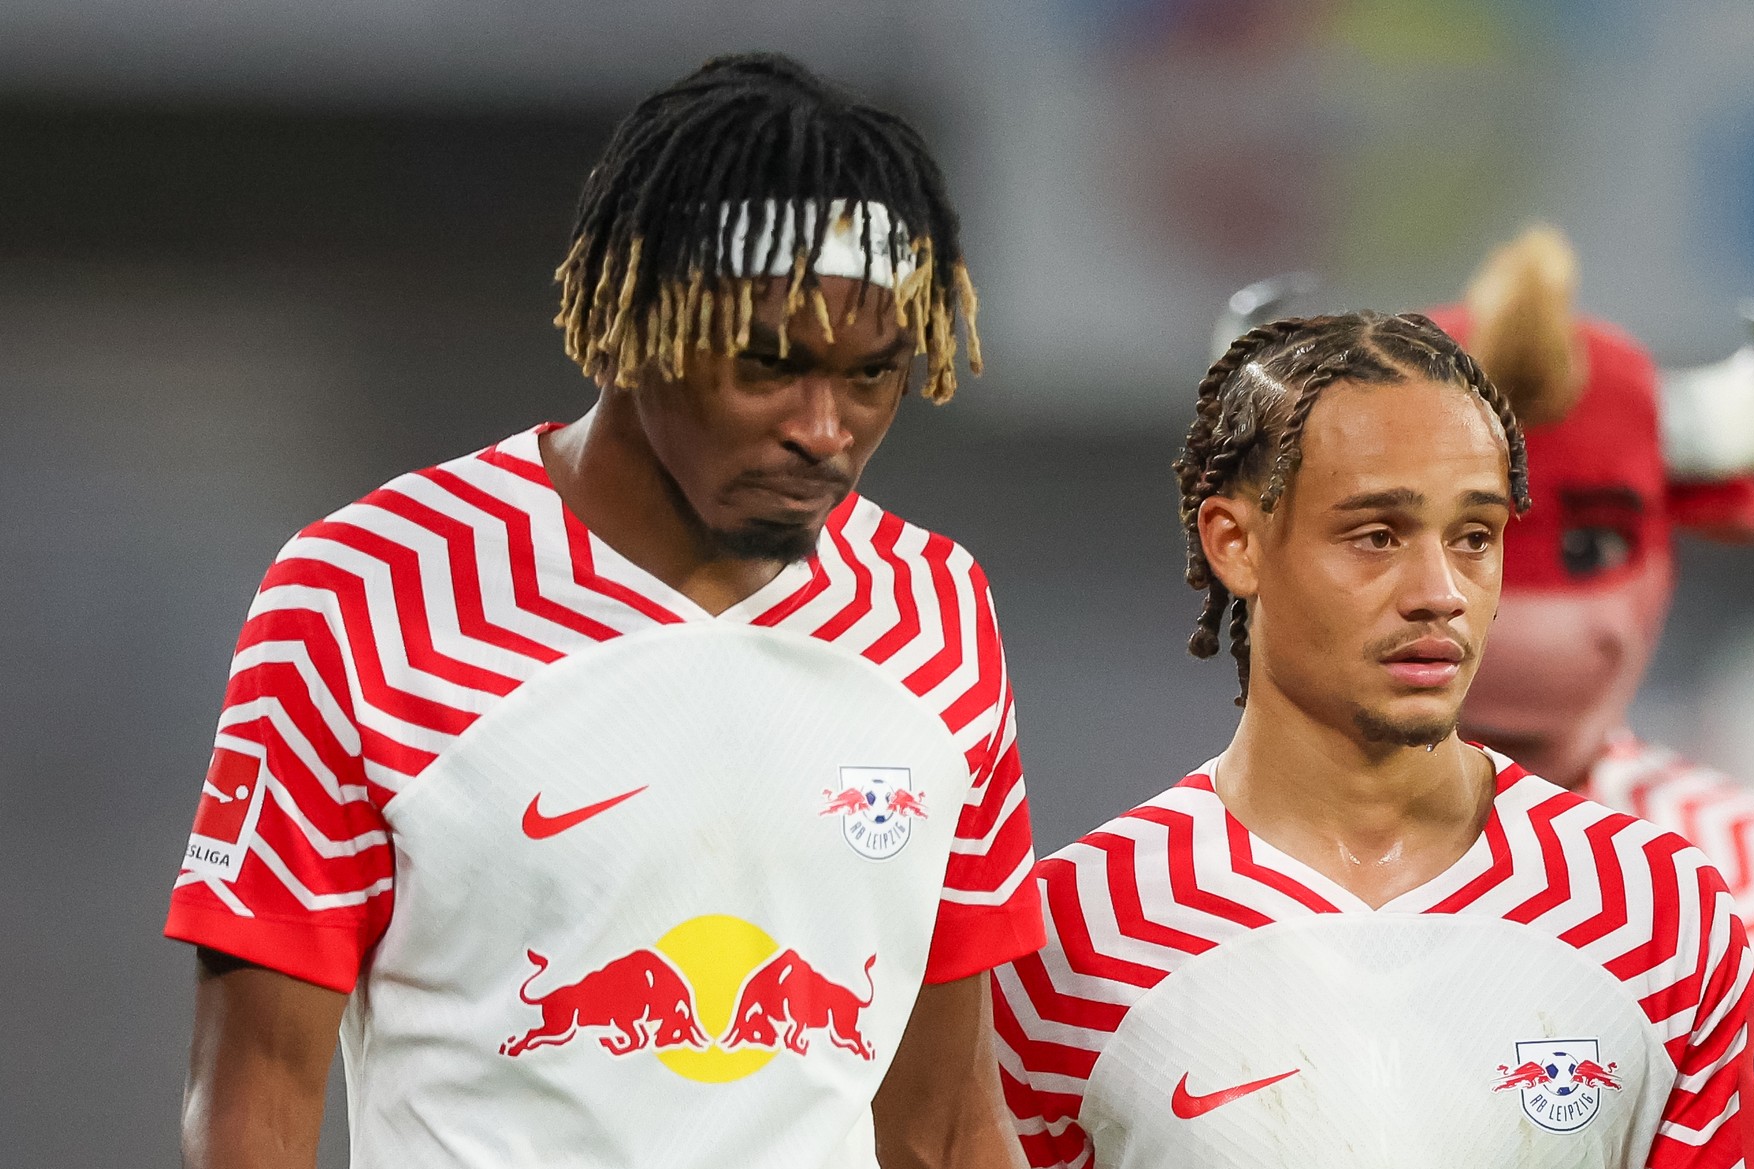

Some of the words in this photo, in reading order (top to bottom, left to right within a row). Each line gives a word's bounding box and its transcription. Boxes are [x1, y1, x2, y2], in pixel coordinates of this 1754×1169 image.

[866, 821, 906, 850] LEIPZIG
[187, 844, 230, 867] SLIGA
[1530, 1094, 1548, 1113] RB
[1549, 1093, 1594, 1121] LEIPZIG
